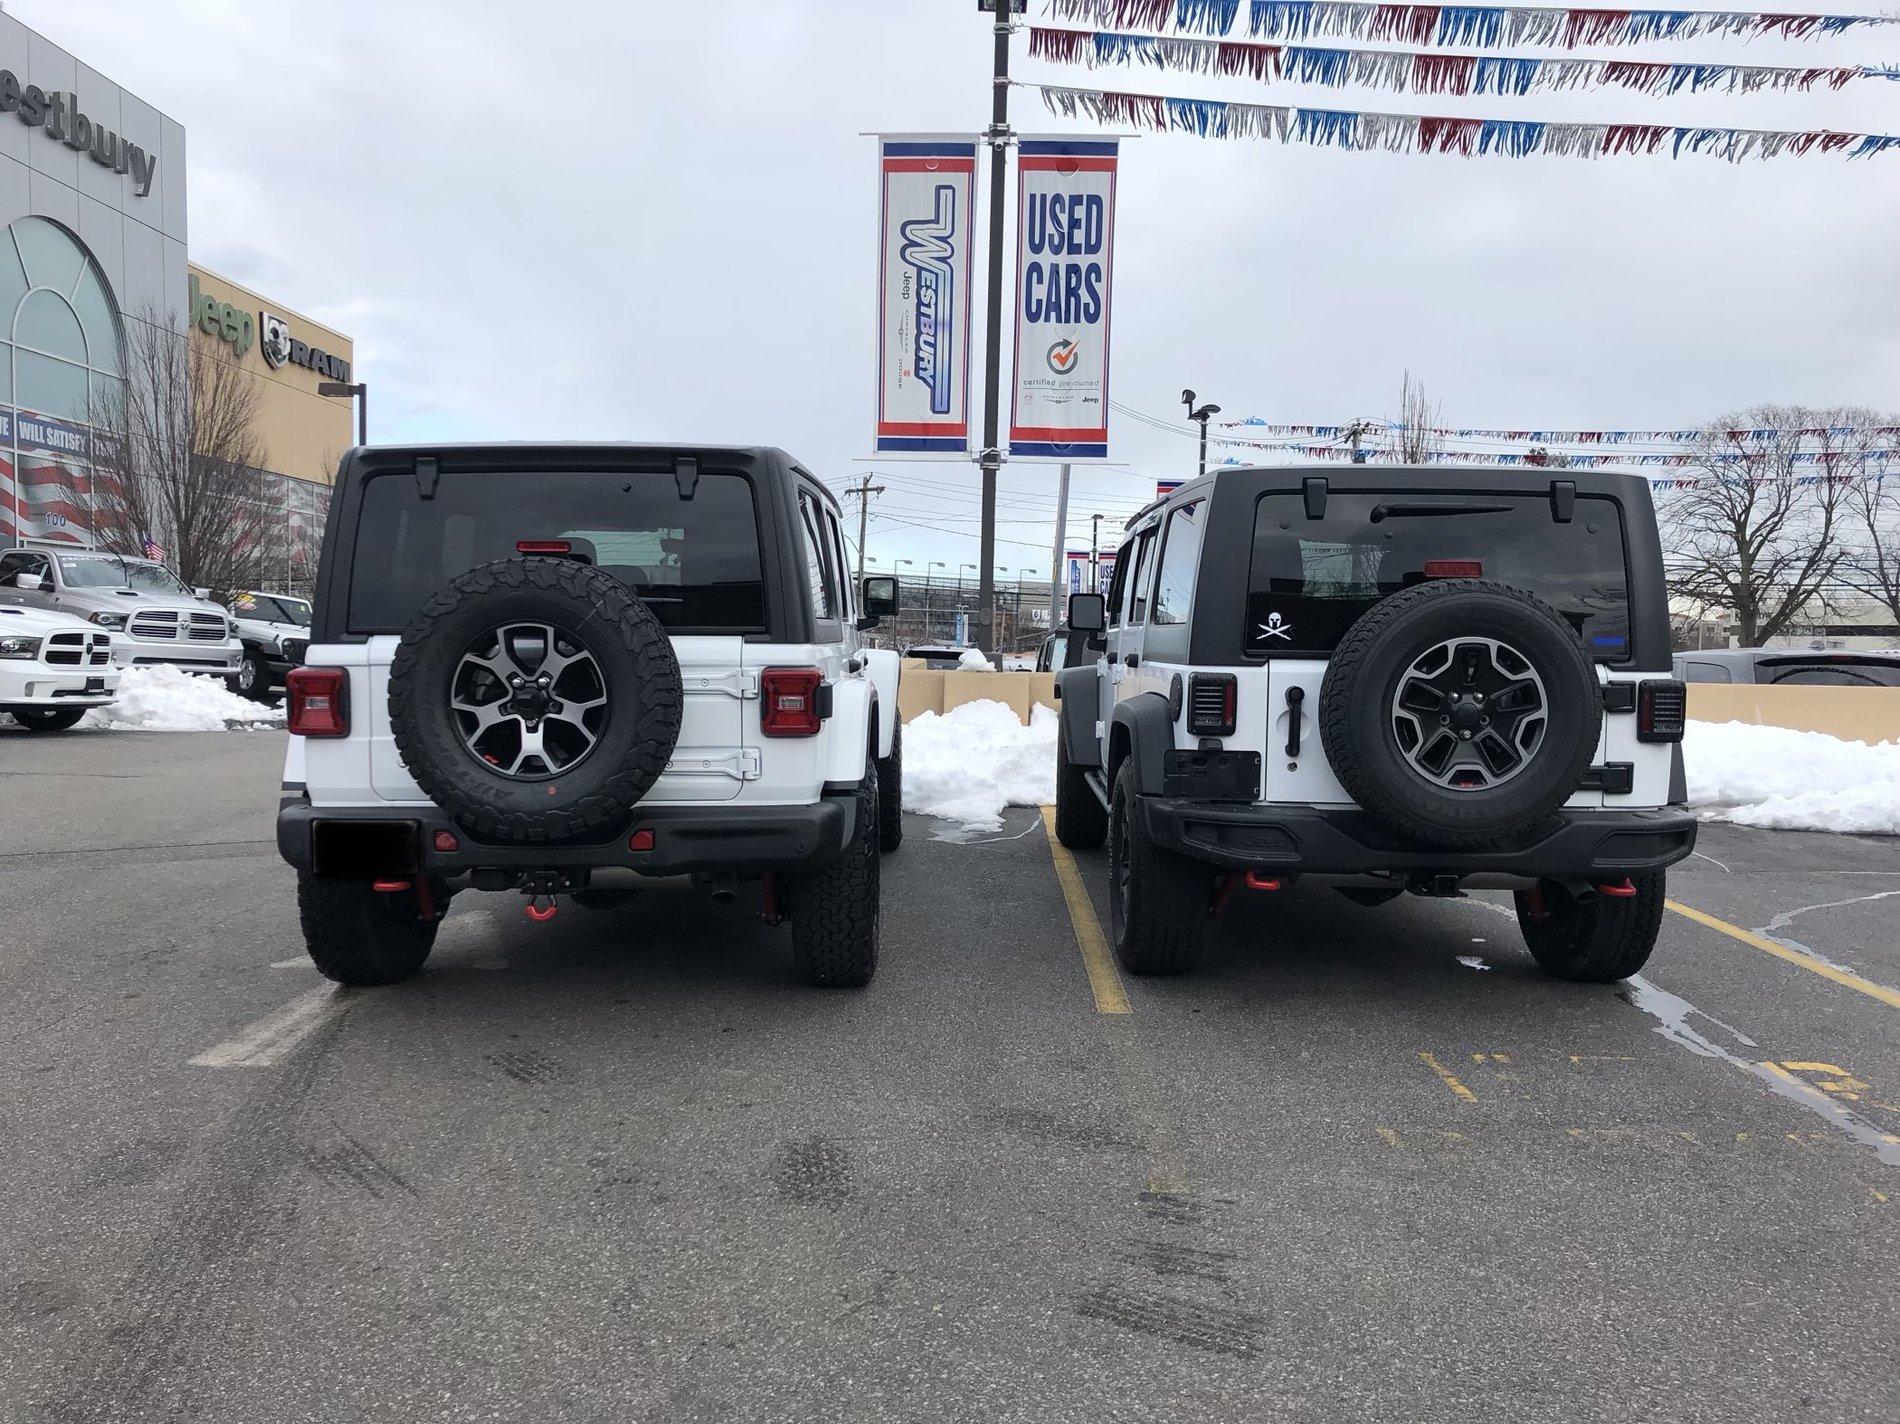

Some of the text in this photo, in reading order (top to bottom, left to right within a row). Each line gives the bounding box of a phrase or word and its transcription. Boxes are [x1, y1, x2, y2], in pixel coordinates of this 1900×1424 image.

[1028, 193, 1104, 256] USED
[901, 271, 912, 300] Jeep
[1025, 261, 1102, 325] CARS
[289, 338, 350, 383] RAM
[1023, 378, 1056, 386] certified
[1081, 396, 1099, 404] Jeep
[19, 420, 45, 444] WILL
[45, 511, 67, 527] 100
[1100, 564, 1114, 579] USE
